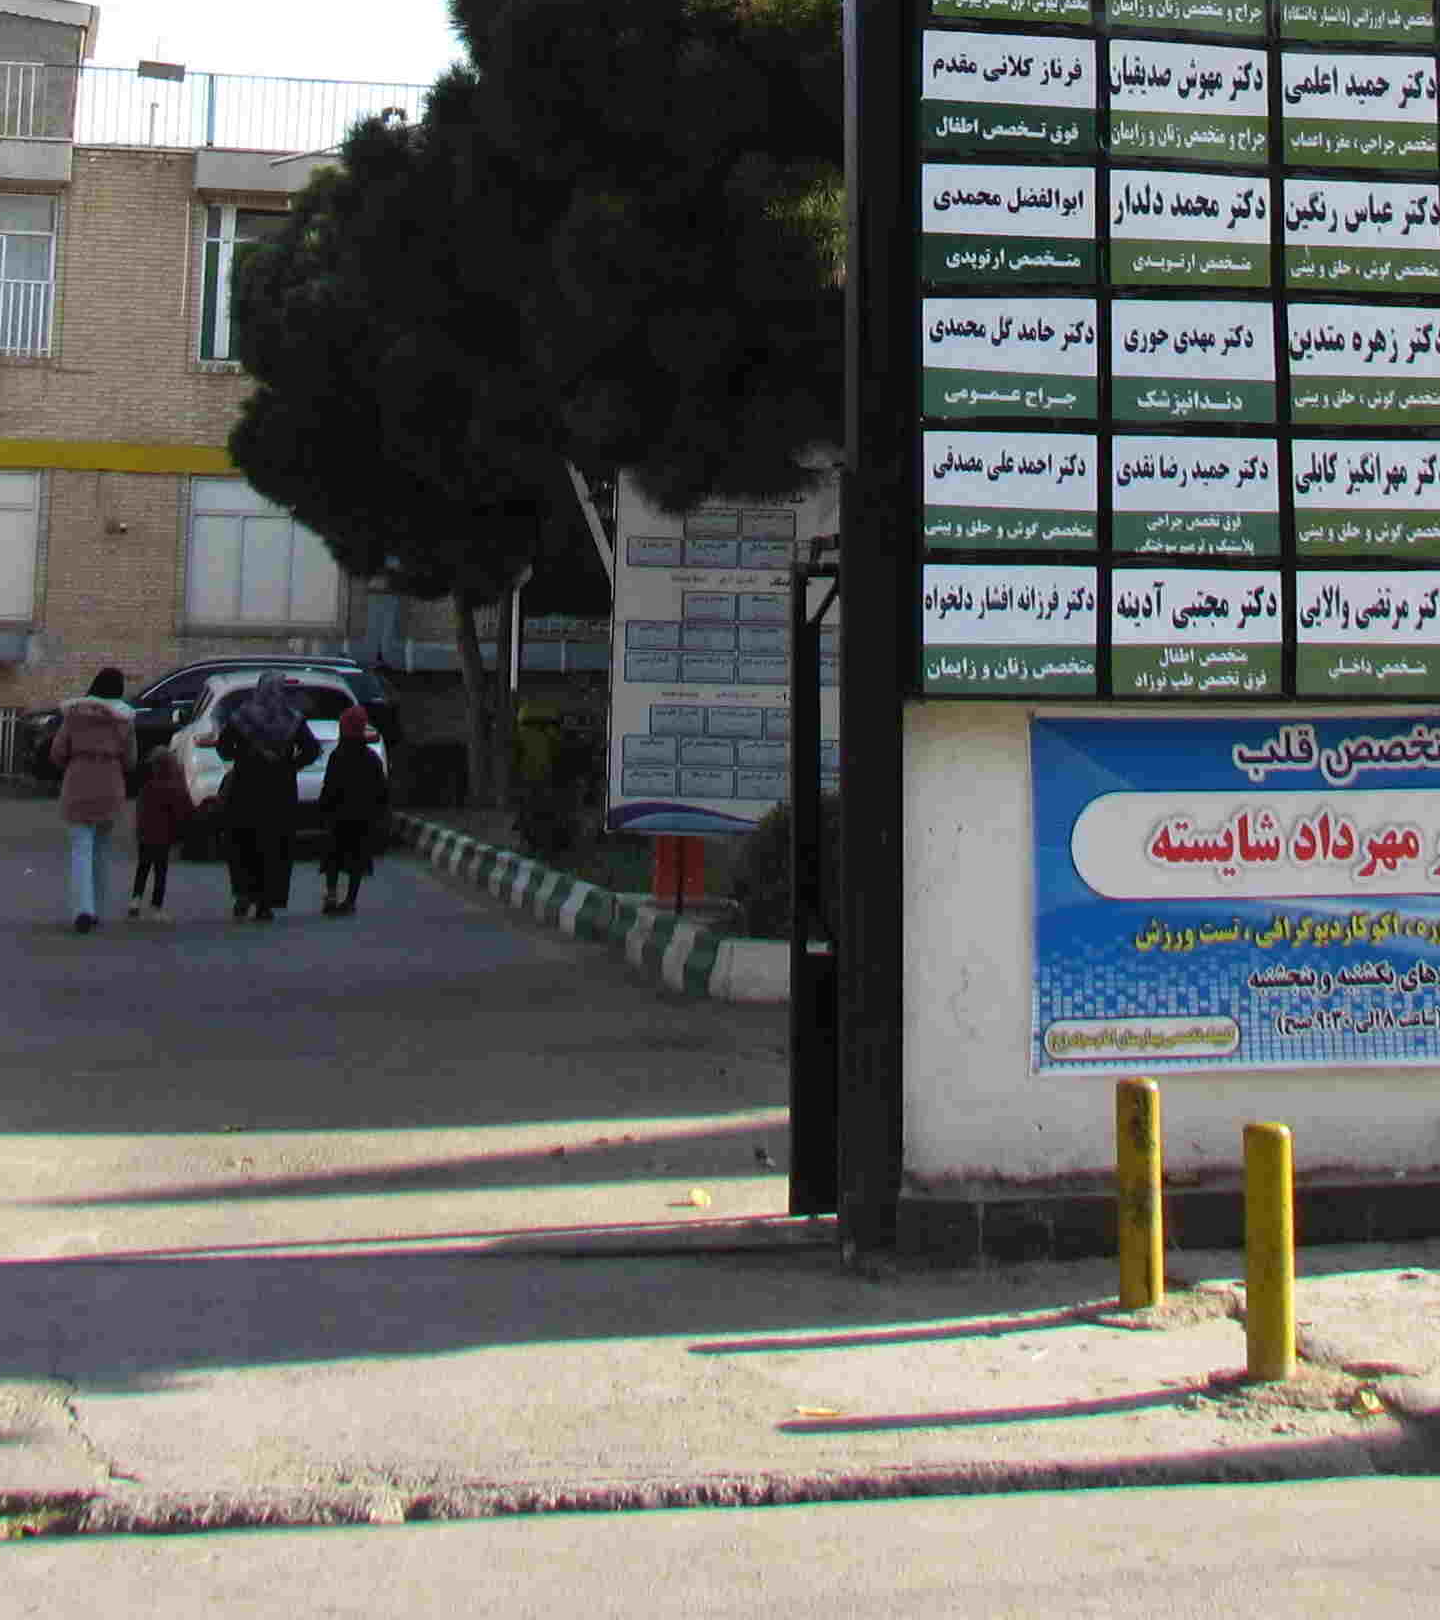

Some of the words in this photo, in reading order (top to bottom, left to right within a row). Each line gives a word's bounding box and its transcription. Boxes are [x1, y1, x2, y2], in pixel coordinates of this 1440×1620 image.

[1229, 62, 1263, 100] دکتر
[1345, 74, 1389, 104] حمید
[1399, 70, 1437, 108] دکتر
[934, 187, 1001, 211] محمدی
[1007, 185, 1083, 215] ابوالفضل
[1113, 183, 1163, 224] دلدار
[1171, 187, 1219, 218] محمد
[1227, 188, 1265, 229] دکتر
[1345, 192, 1393, 233] عباس
[1401, 196, 1440, 235] دکتر
[929, 316, 986, 343] محمدی
[1018, 318, 1054, 343] حامد
[1060, 320, 1094, 351] دکتر
[1174, 327, 1216, 354] مهدی
[1220, 325, 1253, 356] دکتر
[1056, 454, 1086, 484] دکتر
[1236, 456, 1268, 488] دکتر
[1064, 587, 1094, 620] دکتر
[1237, 586, 1277, 628] دکتر
[1234, 727, 1319, 785] قلب
[1150, 811, 1282, 876] شایسته
